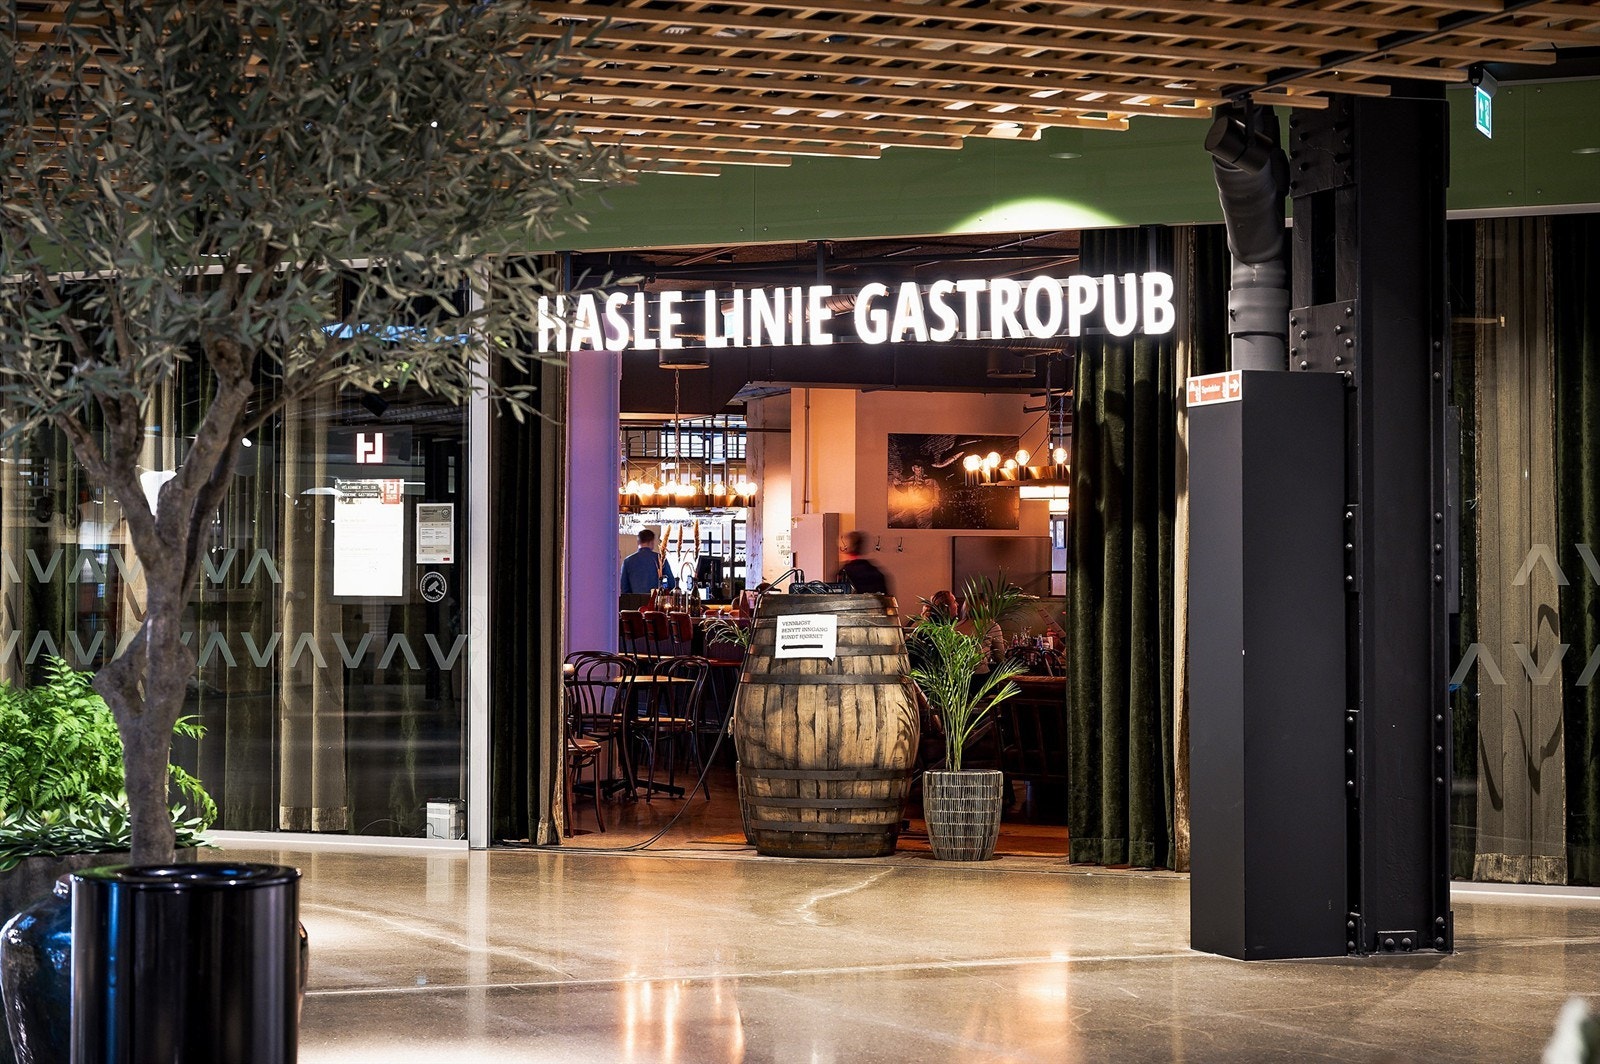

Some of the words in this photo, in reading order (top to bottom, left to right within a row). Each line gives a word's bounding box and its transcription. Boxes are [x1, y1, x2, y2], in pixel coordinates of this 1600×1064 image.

[538, 290, 684, 352] HASLE
[705, 285, 833, 349] LINIE
[854, 271, 1176, 344] GASTROPUB
